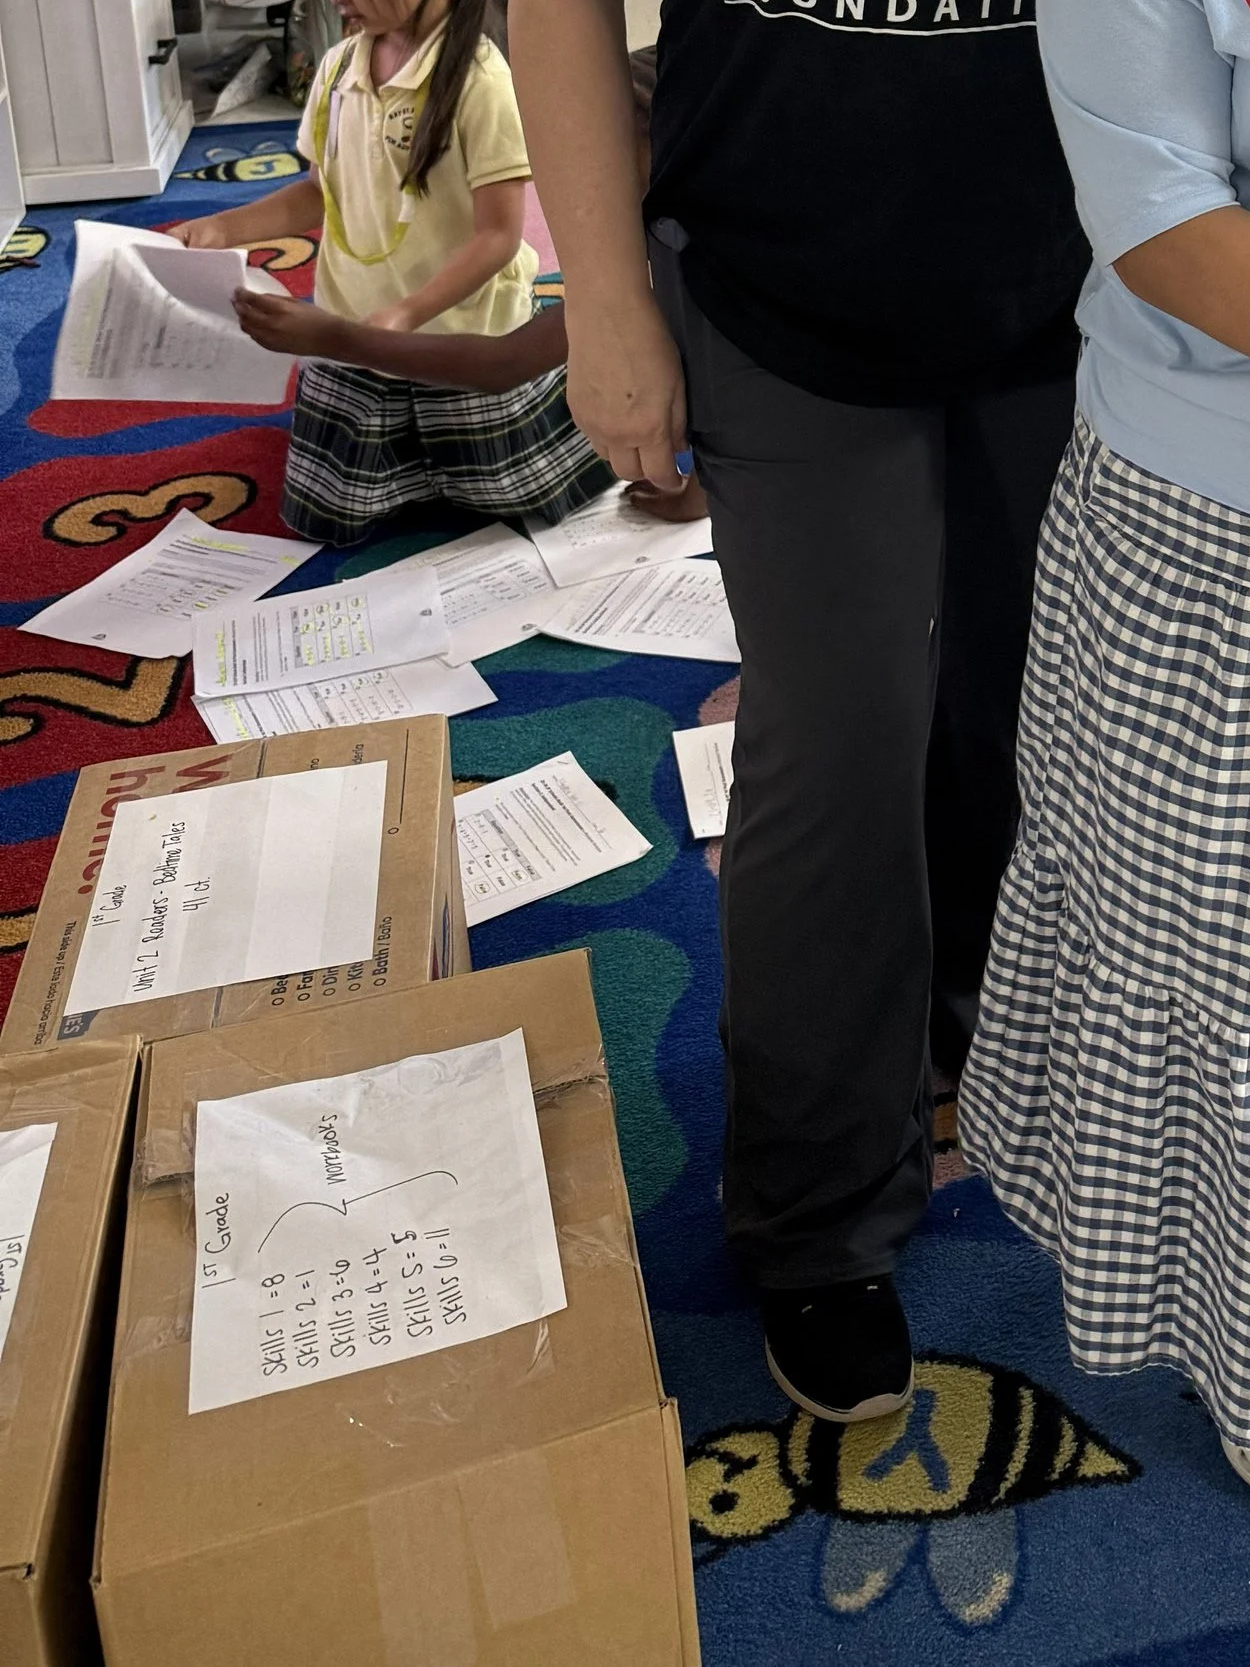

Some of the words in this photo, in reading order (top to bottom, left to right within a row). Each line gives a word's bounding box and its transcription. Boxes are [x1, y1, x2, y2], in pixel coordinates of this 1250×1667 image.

[162, 821, 186, 850] Tales
[153, 848, 182, 886] Bedtime
[100, 884, 128, 912] Grade
[64, 920, 77, 937] This
[142, 896, 168, 943] Readers
[377, 916, 394, 941] Baño
[59, 937, 72, 951] side
[137, 948, 159, 963] 2
[51, 966, 65, 982] Este
[374, 947, 392, 979] Bath
[46, 980, 61, 1000] lado
[133, 964, 158, 993] Unit
[40, 999, 56, 1021] hacia
[33, 1020, 48, 1046] arriba
[205, 1192, 232, 1254] Grade
[295, 1297, 317, 1312] 2
[403, 1287, 433, 1339] Skills
[436, 1276, 467, 1326] Skills
[328, 1306, 356, 1359] Skills
[363, 1300, 392, 1347] Skills
[260, 1328, 288, 1377] Skills
[292, 1320, 320, 1369] Skills
